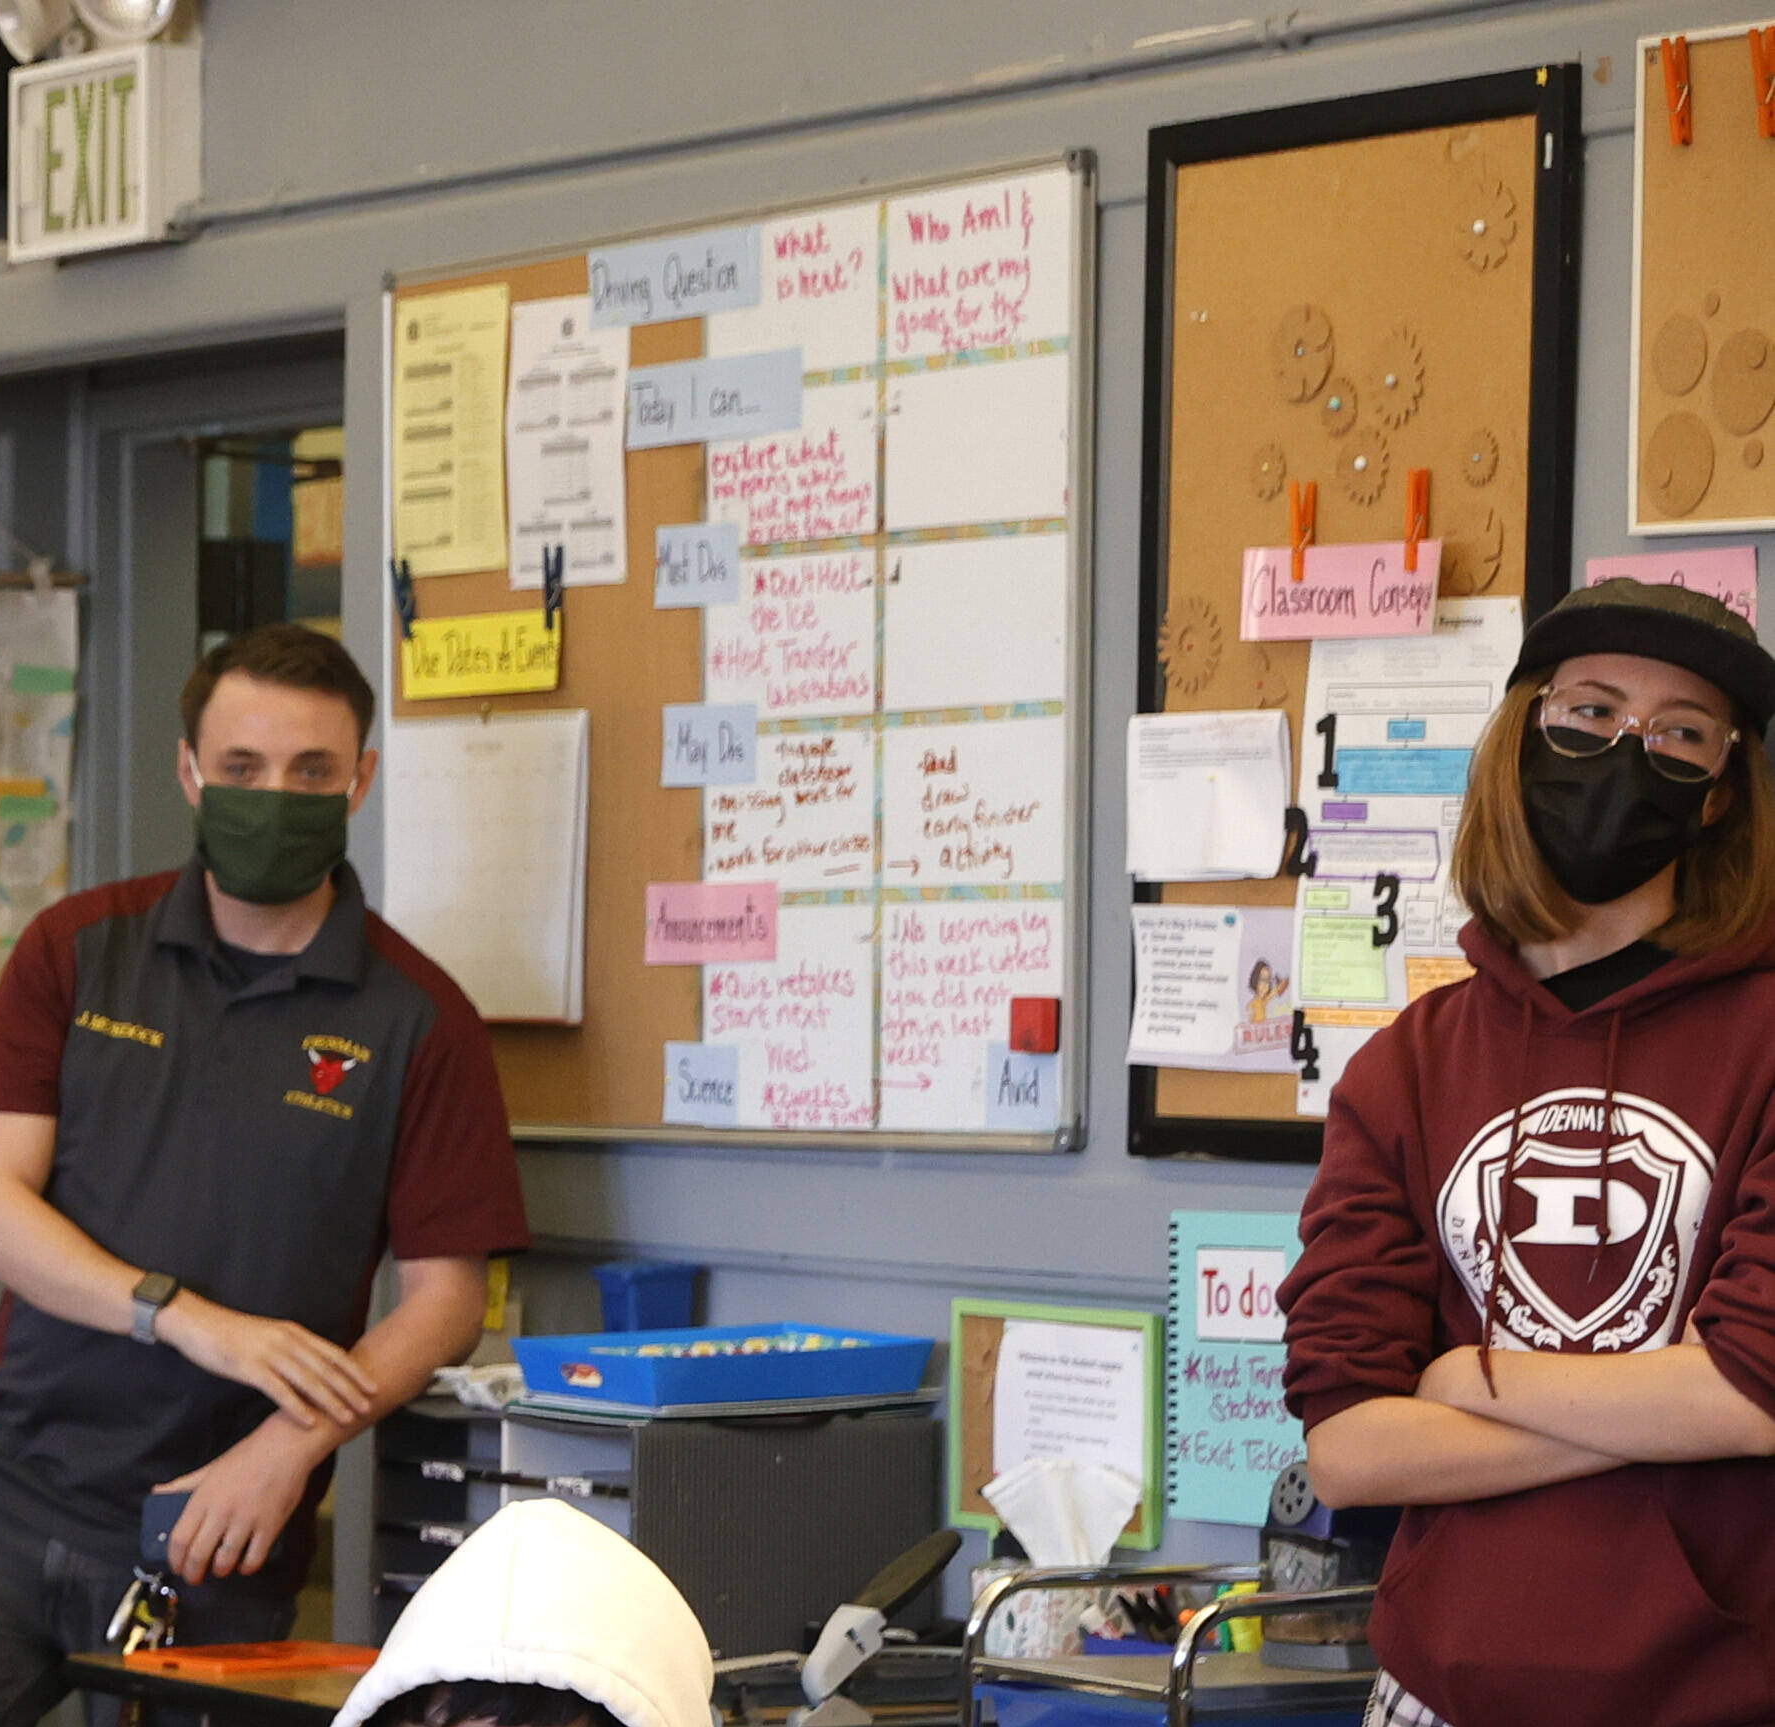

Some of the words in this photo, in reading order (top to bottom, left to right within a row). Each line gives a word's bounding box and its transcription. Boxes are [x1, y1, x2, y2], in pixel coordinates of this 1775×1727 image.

[43, 73, 135, 232] EXIT
[908, 210, 951, 245] Who
[663, 248, 739, 310] Question
[1250, 564, 1358, 619] Classroom
[1316, 712, 1339, 788] 1
[1285, 806, 1318, 878] 2
[1372, 874, 1400, 948] 3
[1290, 1009, 1319, 1080] 4
[1202, 1268, 1231, 1317] To
